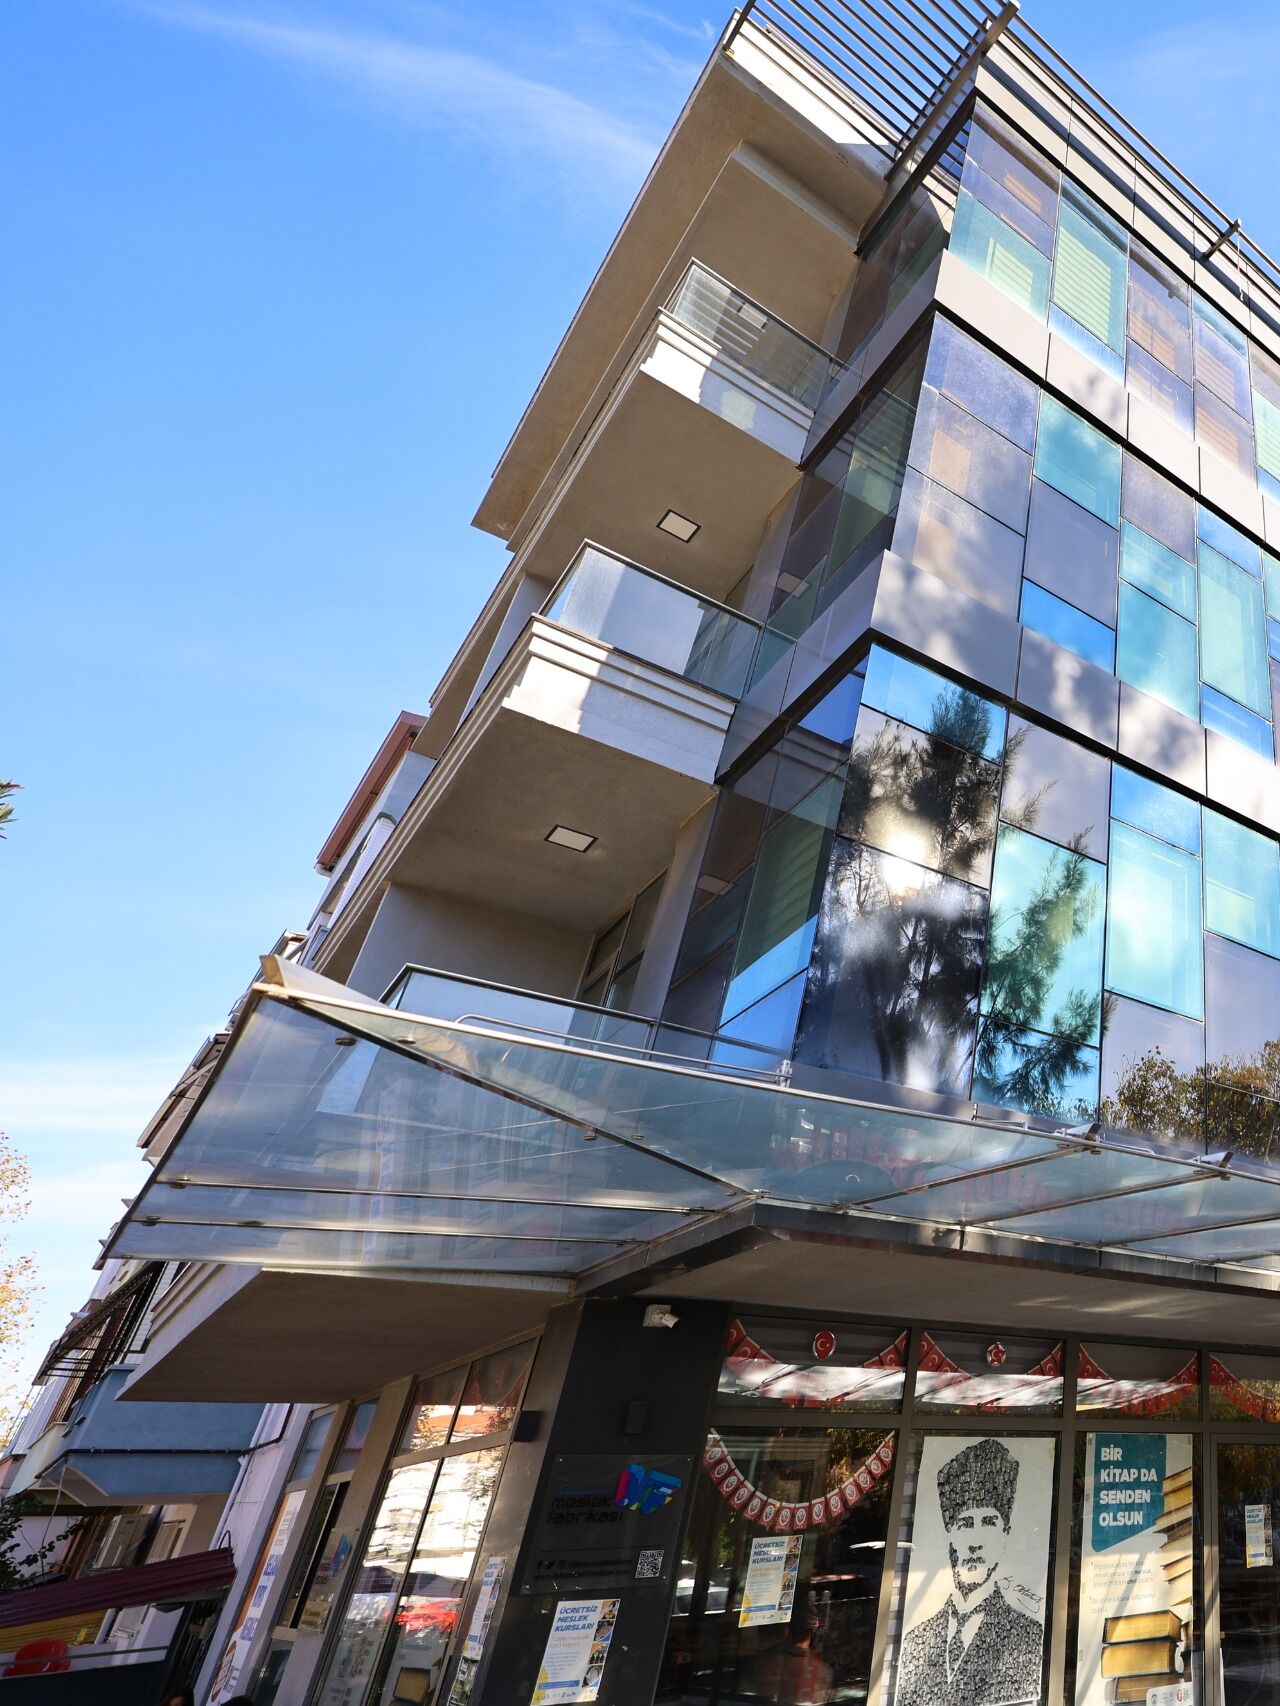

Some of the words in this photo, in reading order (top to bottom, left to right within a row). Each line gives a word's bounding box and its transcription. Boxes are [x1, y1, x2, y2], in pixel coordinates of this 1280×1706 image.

[1101, 1444, 1123, 1461] BİR
[1100, 1466, 1138, 1482] KİTAP
[1140, 1468, 1158, 1482] DA
[551, 1495, 611, 1509] meslek
[1099, 1489, 1151, 1505] SENDEN
[1098, 1511, 1143, 1527] OLSUN
[752, 1556, 784, 1565] KURSLARI
[559, 1604, 599, 1615] ÜCRETSİZ
[556, 1614, 590, 1623] MESLEK
[554, 1622, 595, 1633] KURSLARI
